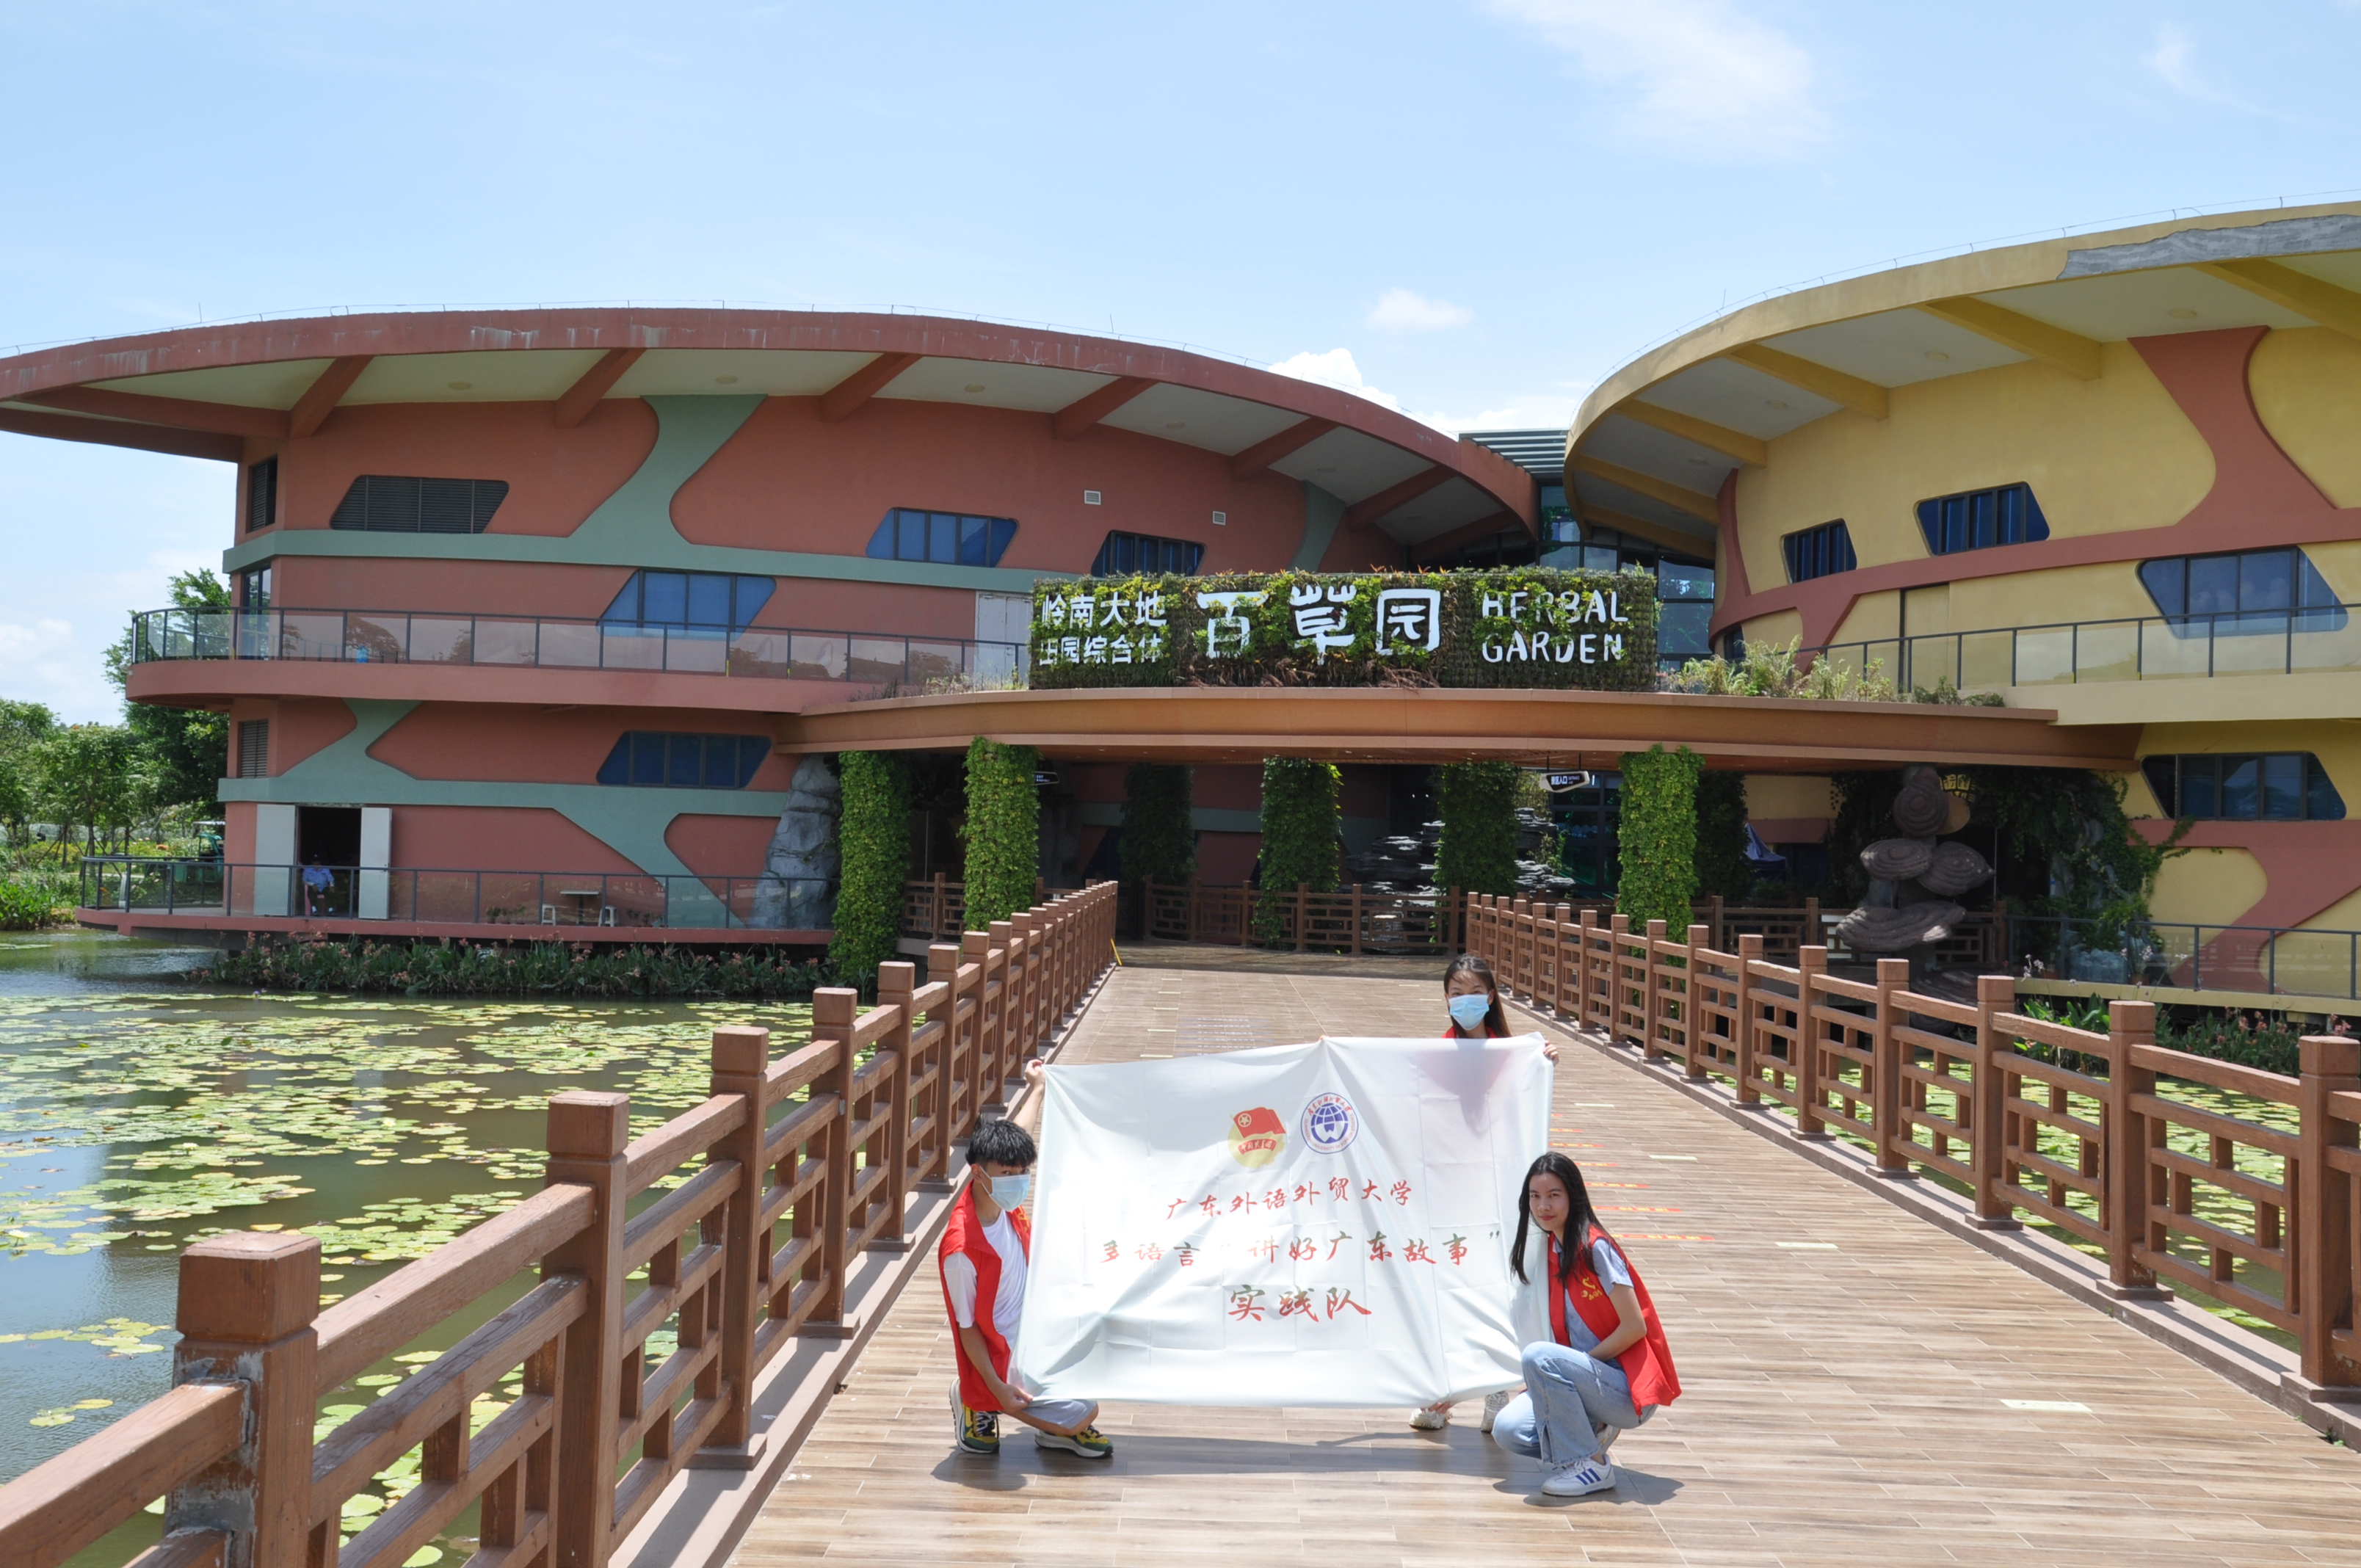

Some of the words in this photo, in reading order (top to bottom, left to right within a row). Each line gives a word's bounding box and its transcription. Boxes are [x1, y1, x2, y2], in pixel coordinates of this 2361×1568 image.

[1042, 589, 1167, 628] 岭南大地
[1197, 584, 1440, 665] 百草园
[1482, 589, 1628, 624] HERBAL
[1482, 630, 1622, 664] GARDEN
[1166, 1177, 1412, 1220] 广东外语外贸大学
[1228, 1284, 1372, 1322] 实践队
